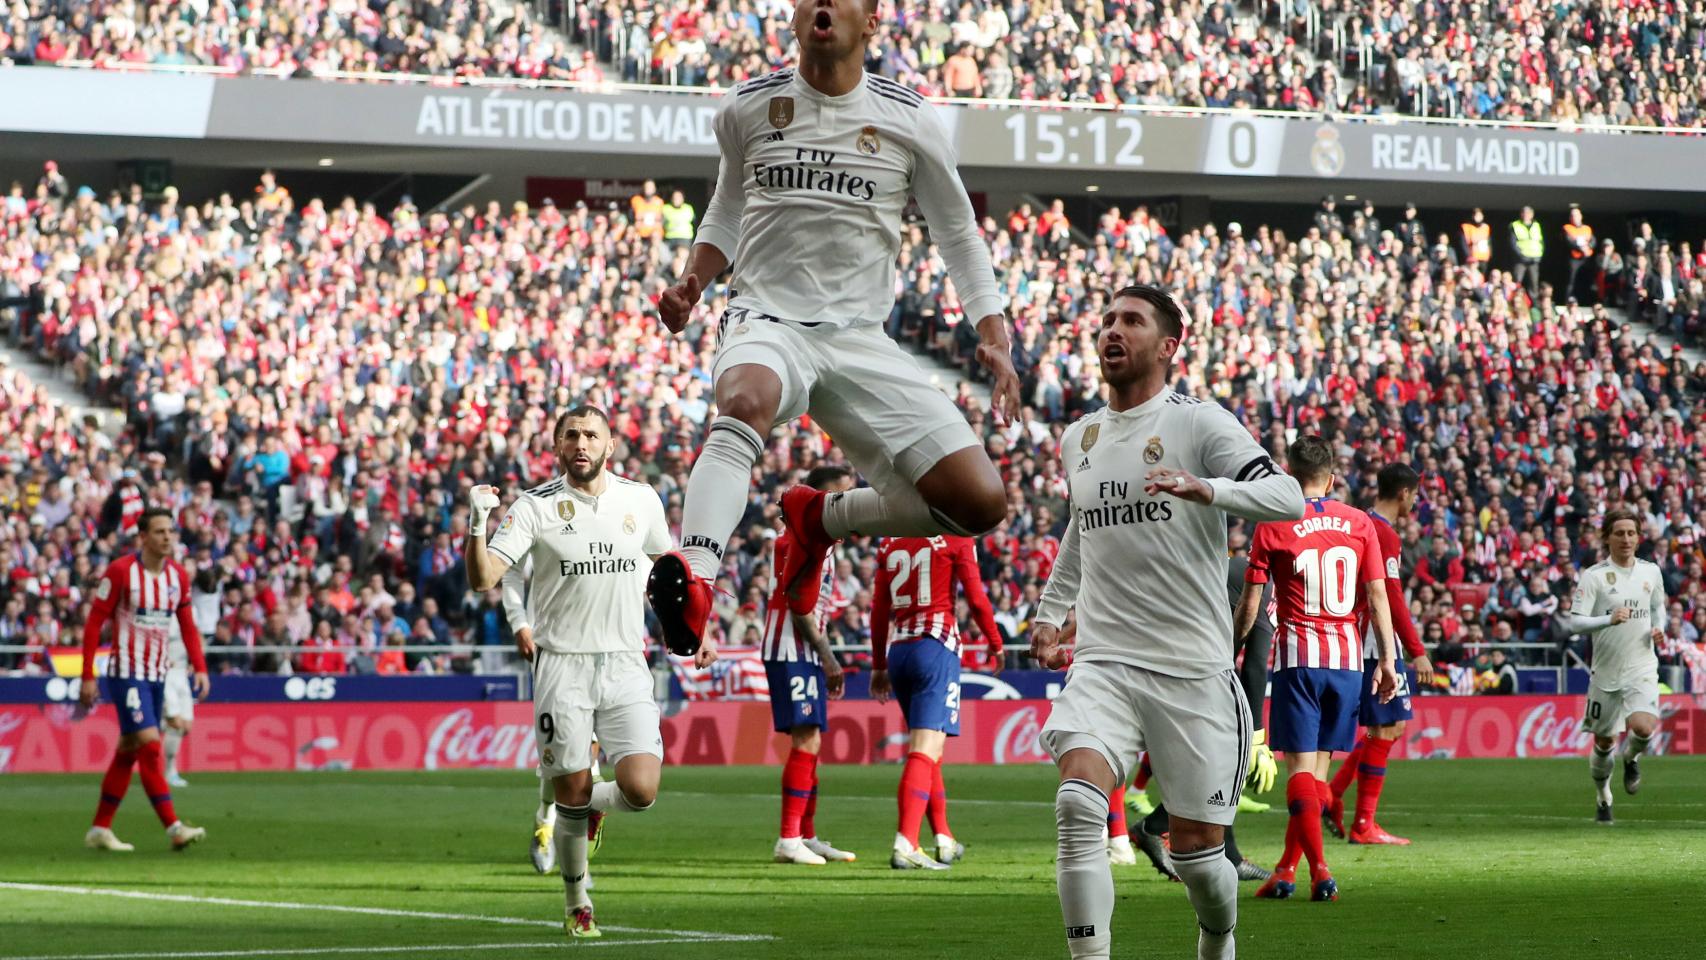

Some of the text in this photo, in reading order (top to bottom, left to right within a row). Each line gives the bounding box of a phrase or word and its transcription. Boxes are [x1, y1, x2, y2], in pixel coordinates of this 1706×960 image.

[416, 88, 718, 145] ATLÉTICO DE MAD
[1004, 112, 1145, 167] 15:12
[1228, 120, 1257, 169] 0
[1371, 132, 1580, 177] REAL MADRID
[795, 147, 836, 167] Fly
[753, 163, 877, 201] Emirates
[1099, 480, 1129, 500] Fly
[1292, 515, 1352, 538] CORREA
[588, 541, 614, 556] Fly
[559, 555, 637, 577] Emirates
[886, 546, 932, 609] 21
[1292, 545, 1358, 617] 10
[126, 686, 142, 710] 4
[789, 675, 820, 701] 24
[1586, 700, 1601, 720] 10
[538, 711, 555, 745] 9
[15, 714, 422, 773] ADESIVO
[1206, 799, 1226, 807] adidas
